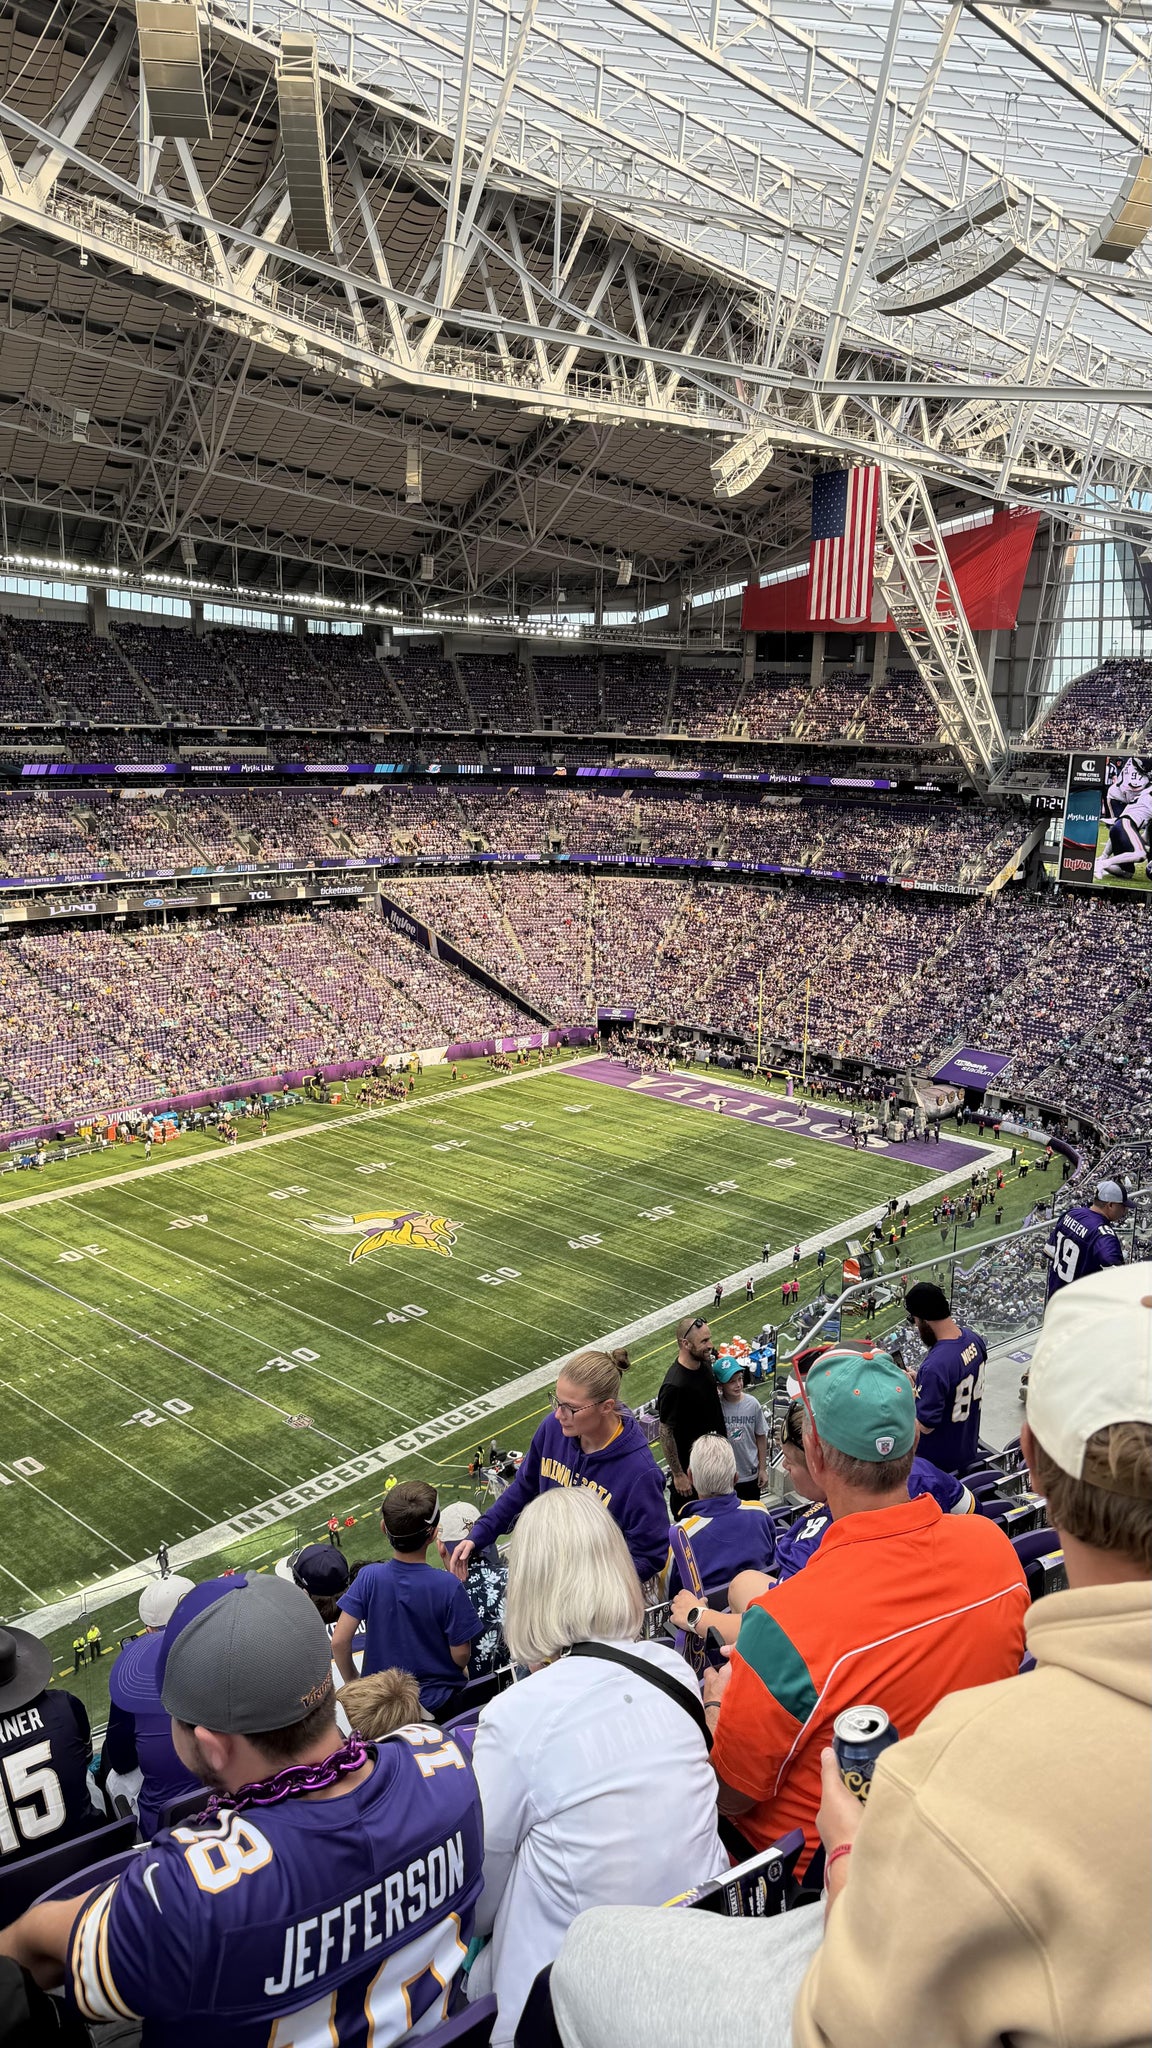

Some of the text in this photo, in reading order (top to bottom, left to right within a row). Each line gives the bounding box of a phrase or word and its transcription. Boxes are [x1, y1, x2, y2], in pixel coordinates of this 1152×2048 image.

[1036, 797, 1064, 810] 17:24
[248, 891, 272, 900] TCL
[320, 886, 365, 895] ticketmaster
[49, 903, 97, 916] LUND
[107, 1107, 143, 1124] VIKINGS
[704, 1179, 739, 1195] 20
[637, 1205, 675, 1222] 30
[567, 1235, 603, 1251] 40
[1053, 1231, 1080, 1283] 19
[477, 1267, 522, 1286] 50
[386, 1304, 429, 1325] 40
[266, 1347, 321, 1373] 30
[951, 1361, 986, 1423] 84
[131, 1397, 194, 1428] 20
[724, 1416, 756, 1424] LPHINS
[226, 1400, 497, 1535] INTERCEPT CANCER
[0, 1739, 67, 1857] 15
[263, 1830, 466, 1998] JEFFERSON
